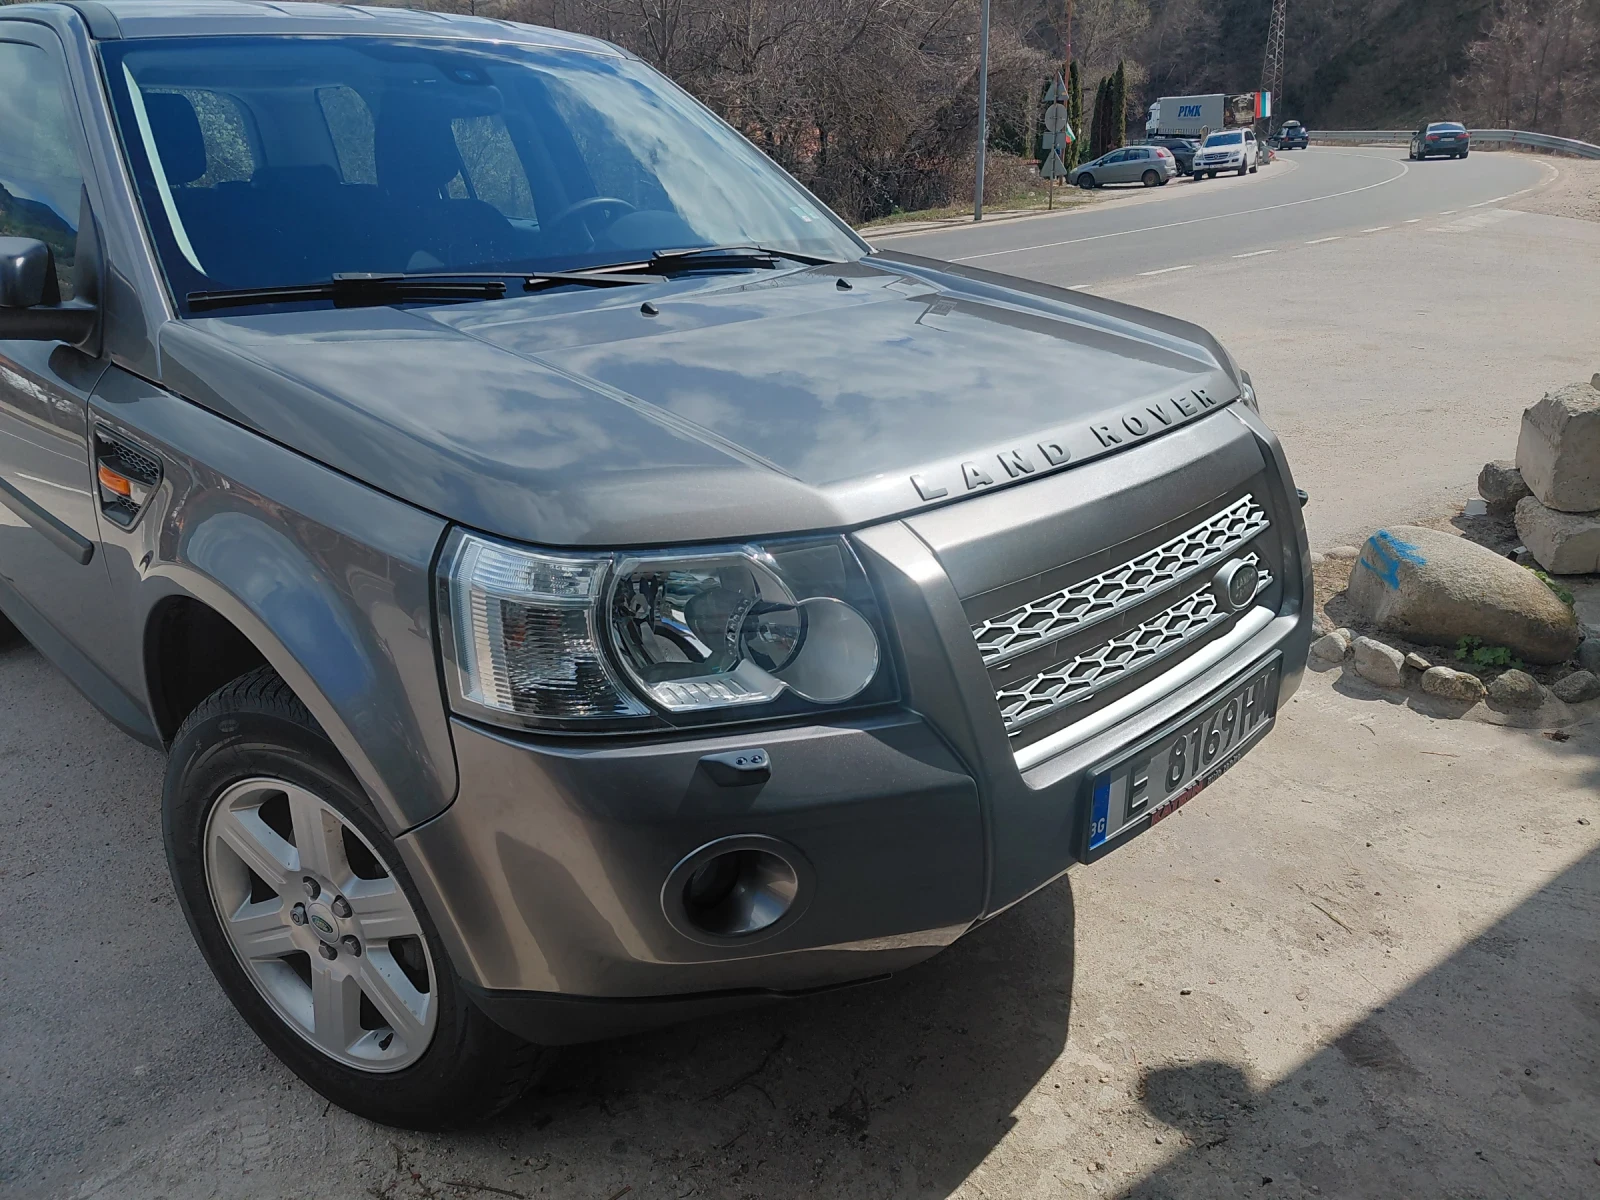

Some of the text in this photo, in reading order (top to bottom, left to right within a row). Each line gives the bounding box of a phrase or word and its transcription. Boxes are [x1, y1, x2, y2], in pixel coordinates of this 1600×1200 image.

[1178, 105, 1202, 117] PIMK
[910, 388, 1217, 501] LAND ROVER
[1125, 759, 1151, 820] E
